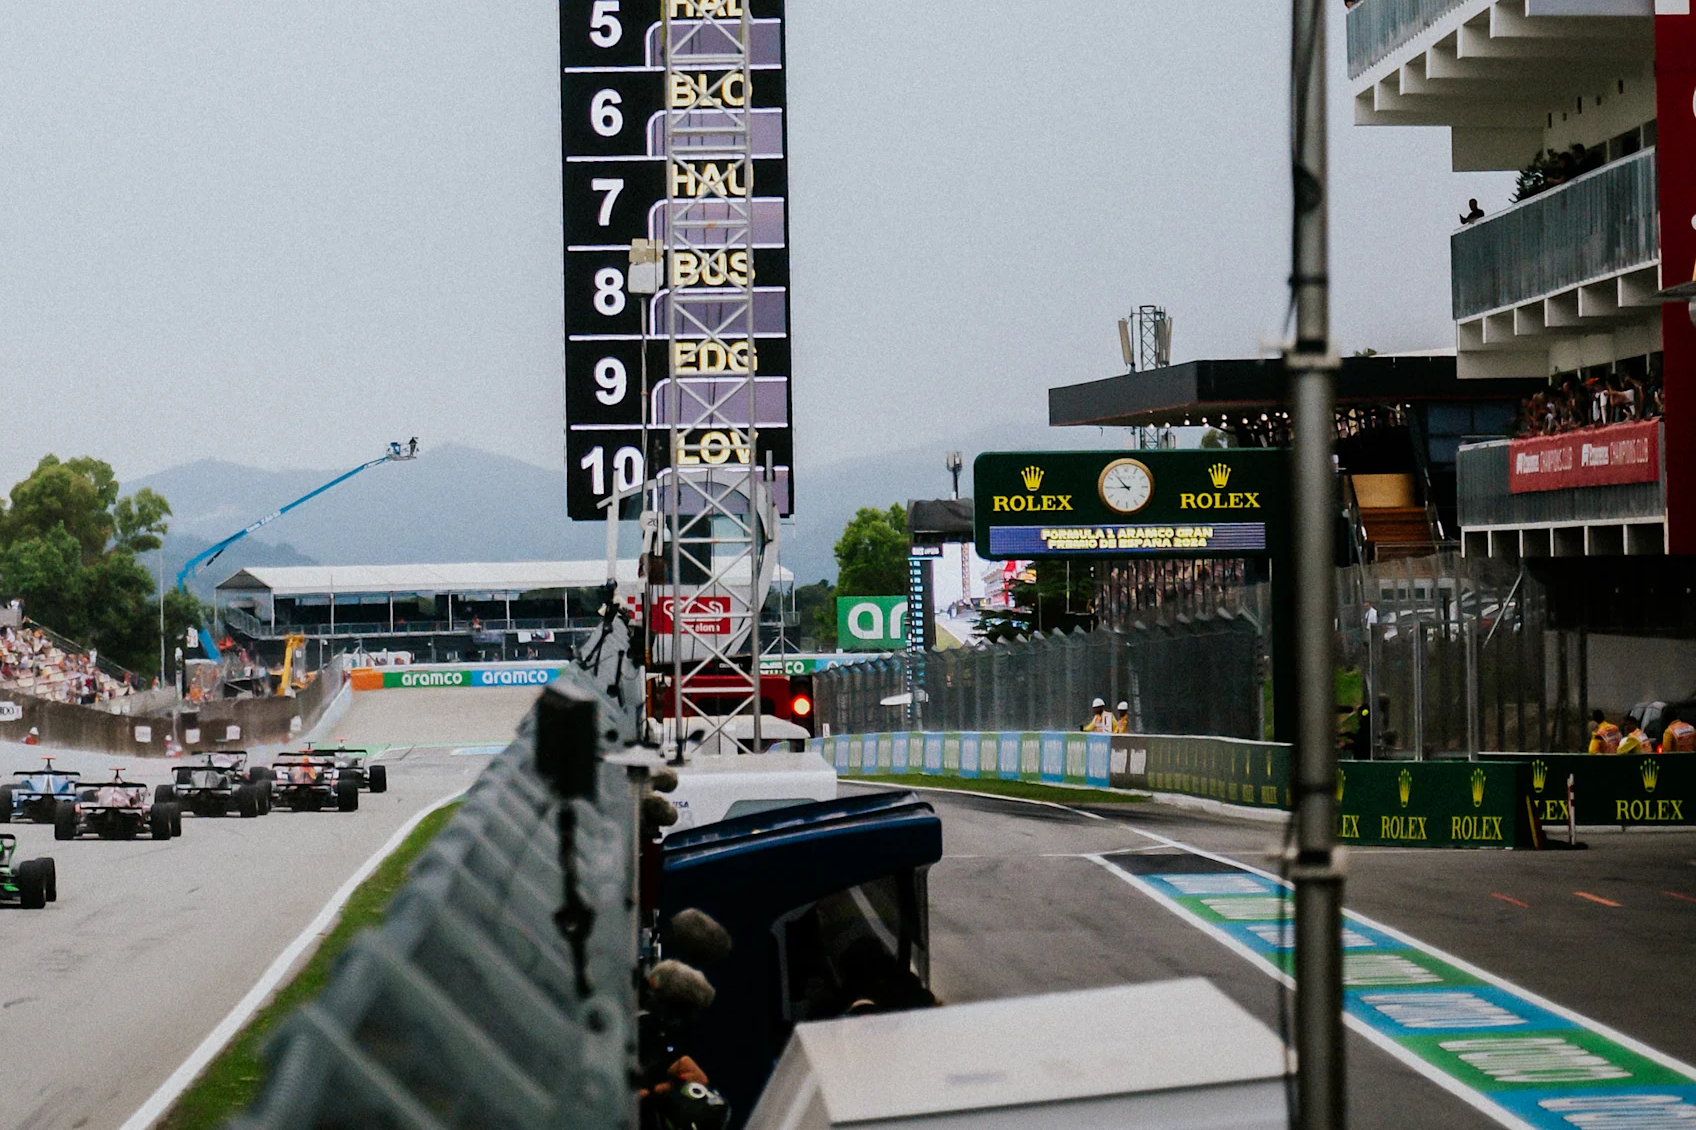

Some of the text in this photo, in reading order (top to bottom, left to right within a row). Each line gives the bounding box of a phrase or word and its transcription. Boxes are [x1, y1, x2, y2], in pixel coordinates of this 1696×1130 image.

[589, 0, 623, 48] 5
[590, 73, 753, 137] 6 BLO
[591, 162, 754, 226] 7 HAU
[593, 251, 756, 316] 8 BUS
[594, 342, 758, 405] 9 EDG
[580, 431, 759, 495] 10 LOV
[993, 495, 1073, 512] ROLEX
[1180, 492, 1261, 509] ROLEX
[1041, 526, 1214, 540] FORMULA 1 ARAMCO GRAN
[1047, 538, 1098, 550] PREMIO
[1099, 538, 1117, 549] DE
[1173, 537, 1208, 548] 2024
[401, 669, 548, 686] aramco aramco
[1616, 799, 1684, 821] ROLEX
[1381, 816, 1428, 840] ROLEX
[1451, 816, 1503, 841] ROLEX
